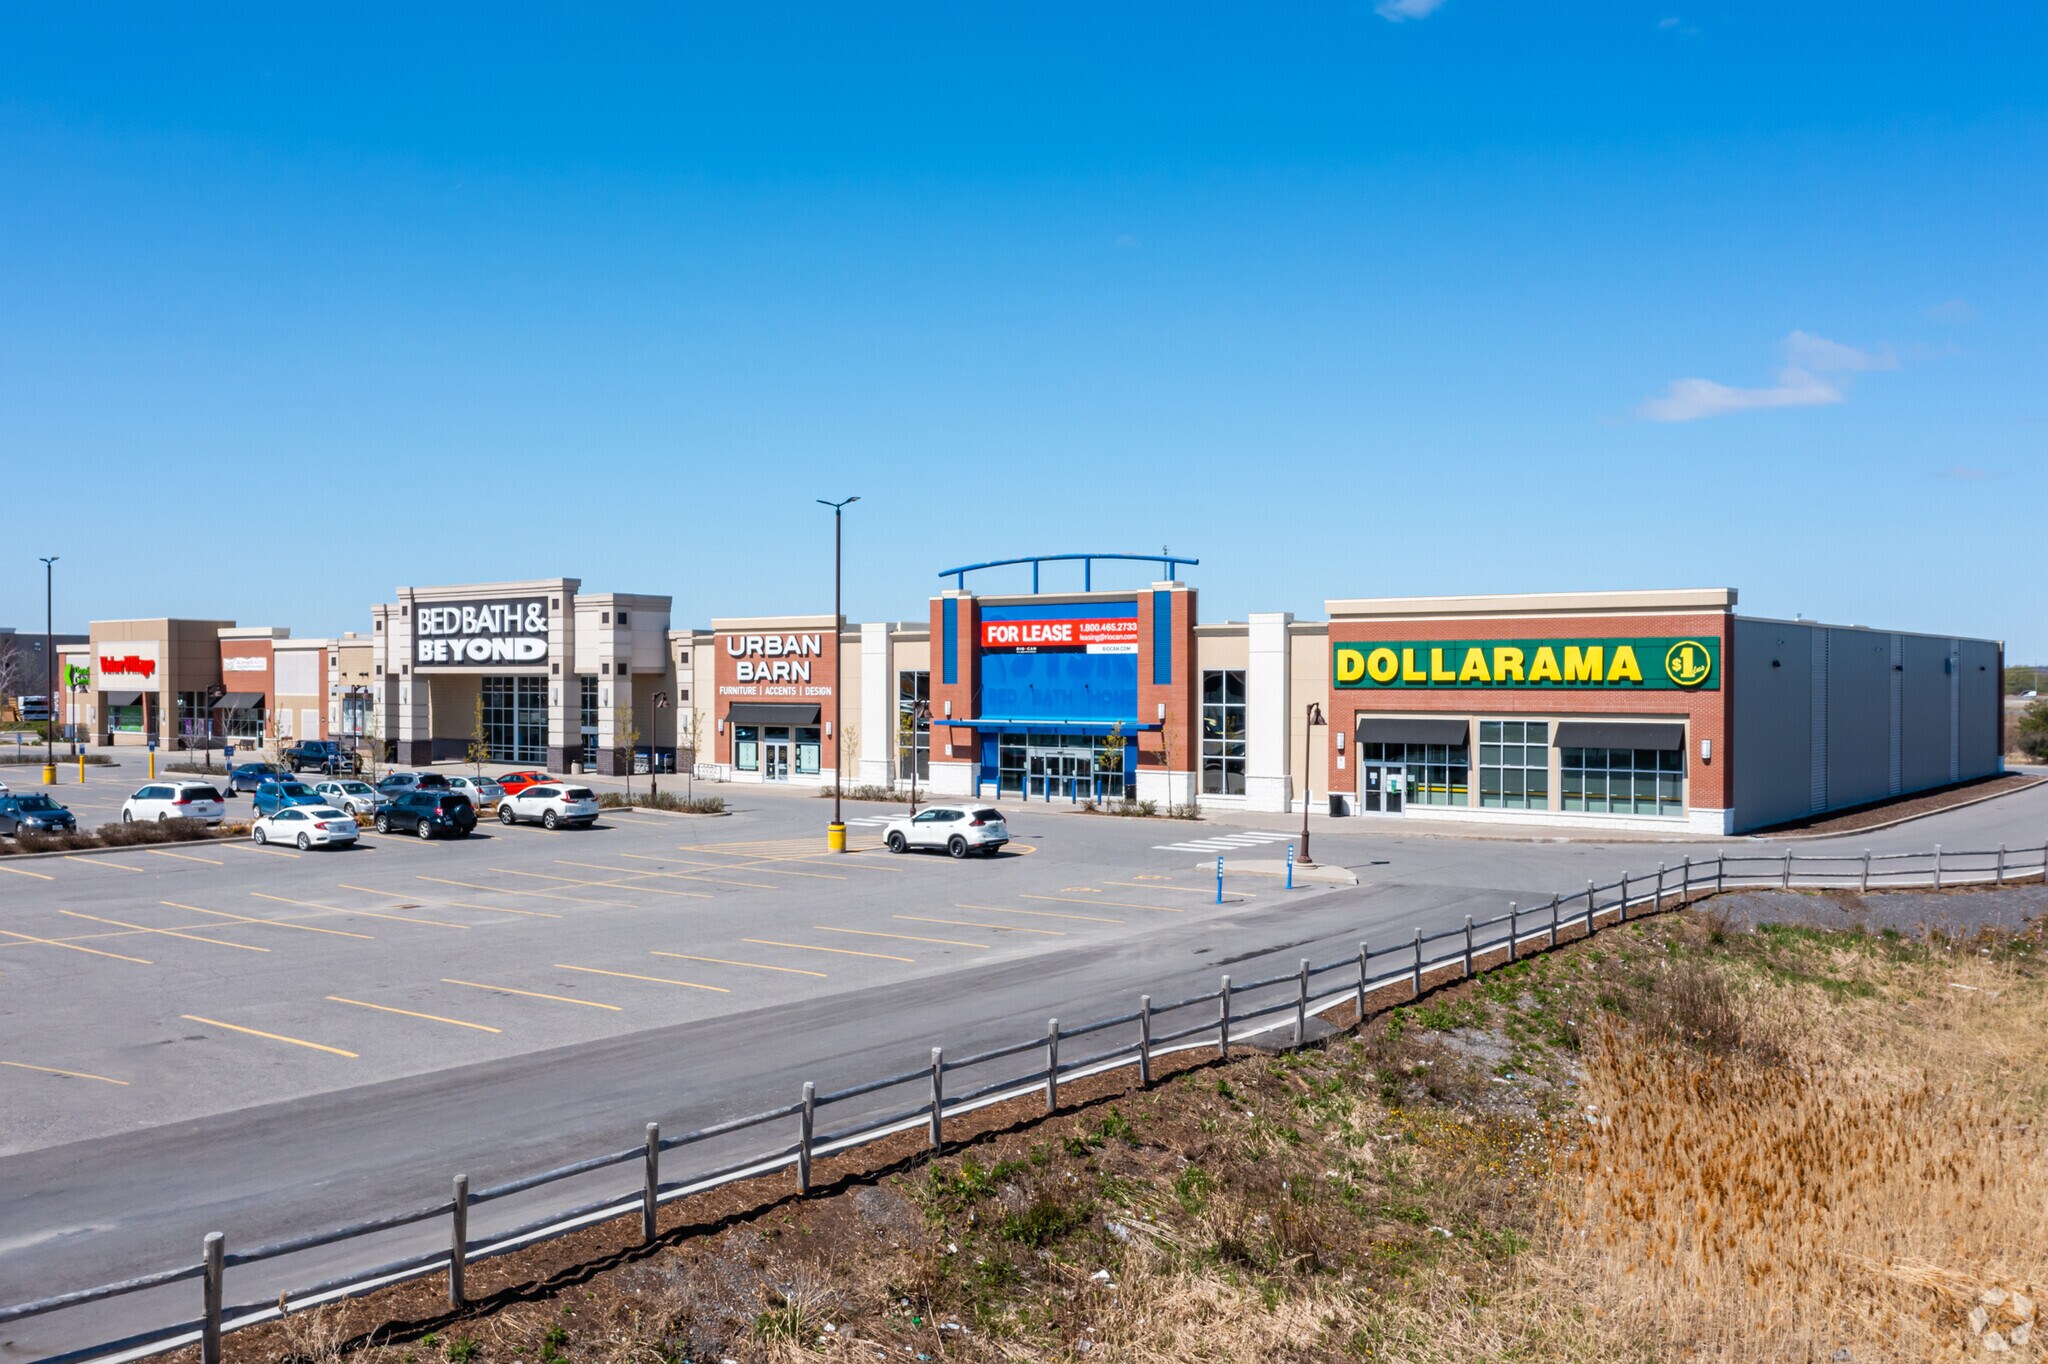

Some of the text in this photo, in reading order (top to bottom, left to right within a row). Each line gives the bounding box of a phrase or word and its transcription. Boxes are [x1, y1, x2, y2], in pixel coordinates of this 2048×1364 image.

[418, 602, 548, 635] BED BATH &
[1079, 622, 1138, 632] 1.800.465.2733
[987, 624, 1072, 643] FOR LEASE
[1079, 633, 1138, 642] leasing@riocan.com
[418, 637, 548, 663] BEYOND
[727, 635, 822, 657] URBAN
[99, 655, 155, 679] Value Village
[736, 661, 811, 683] BARN
[1337, 646, 1643, 682] DOLLARAMA
[719, 686, 832, 696] FURNITURE ACCENTS DESIGN
